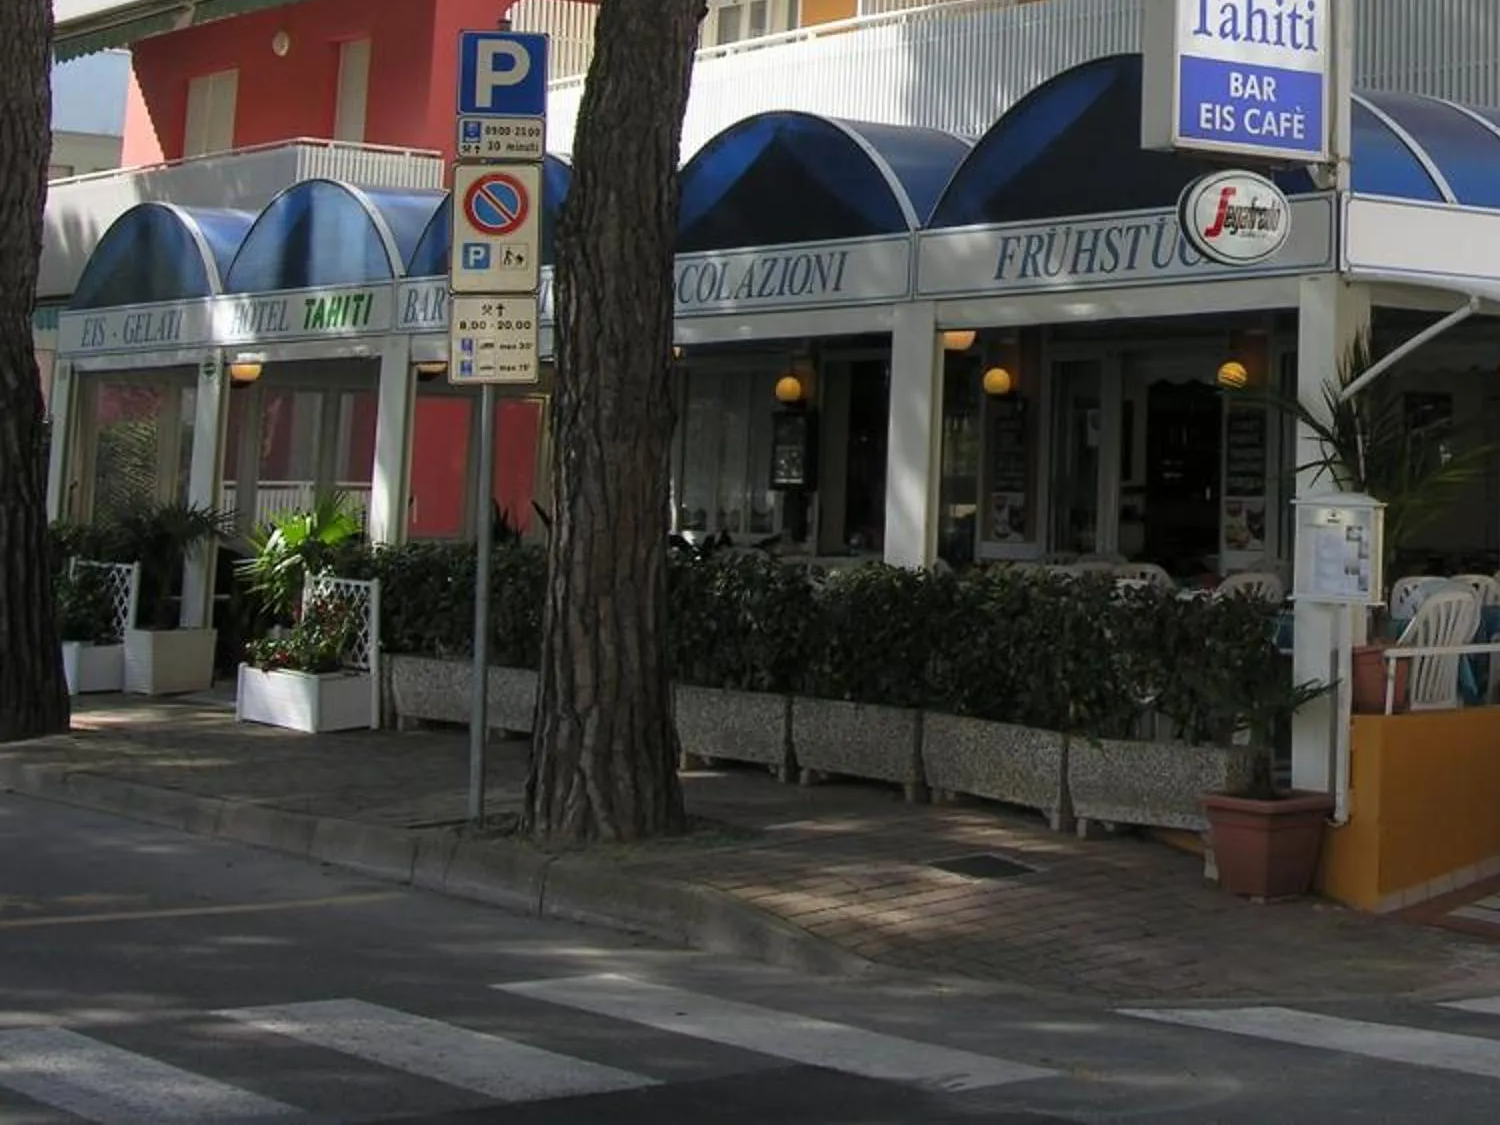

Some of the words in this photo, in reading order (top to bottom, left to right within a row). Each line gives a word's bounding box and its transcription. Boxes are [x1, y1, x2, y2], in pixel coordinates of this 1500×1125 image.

[475, 38, 532, 108] P
[1229, 72, 1277, 103] BAR
[1200, 103, 1236, 132] EIS
[468, 246, 486, 268] P
[994, 217, 1213, 280] FRÜHSTÜC
[677, 250, 849, 305] COLAZIONI
[230, 298, 289, 335] HOTEL
[302, 292, 374, 330] TAHITI
[404, 285, 446, 325] BAR
[81, 316, 106, 348] EIS
[122, 308, 184, 344] GELATI
